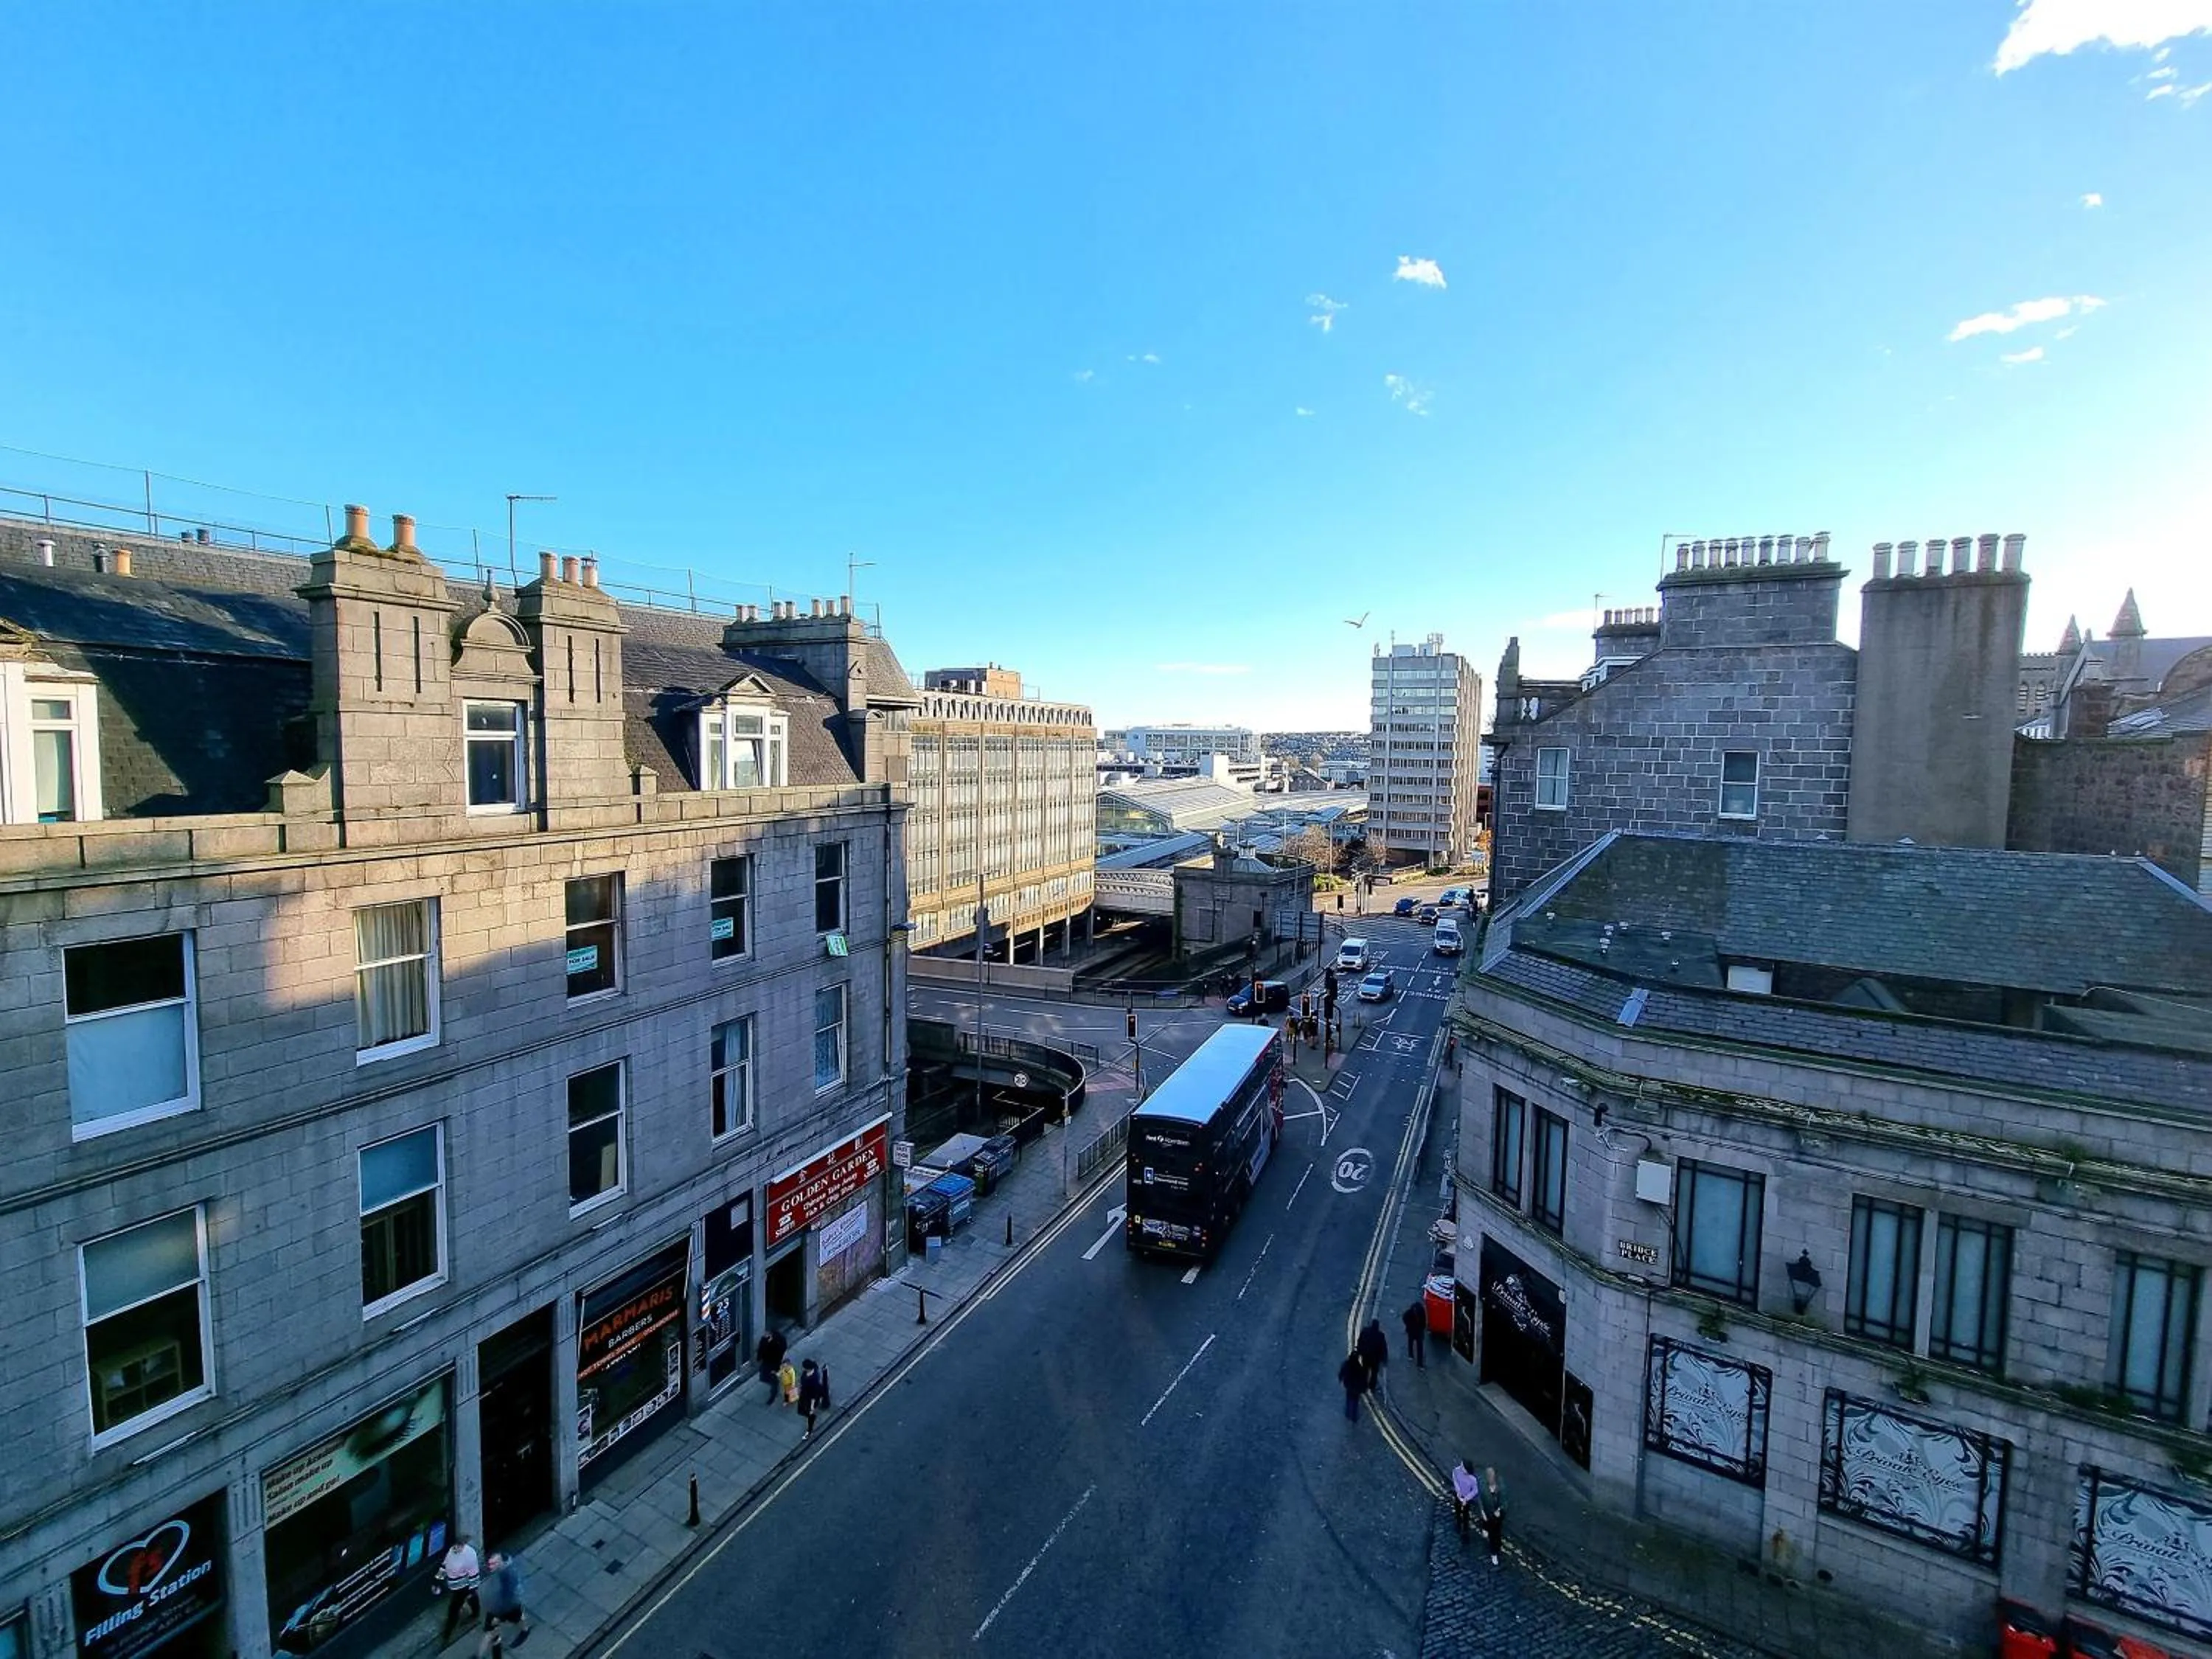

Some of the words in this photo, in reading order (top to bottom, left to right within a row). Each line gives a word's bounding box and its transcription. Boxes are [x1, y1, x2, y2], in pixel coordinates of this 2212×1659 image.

[781, 1176, 830, 1212] GOLDEN
[832, 1147, 876, 1181] GARDEN
[803, 1192, 827, 1211] Chinese
[1619, 1240, 1658, 1257] BRIDGE
[1621, 1248, 1656, 1265] PLACE
[716, 1297, 729, 1315] 23
[1491, 1280, 1526, 1312] Private
[582, 1284, 675, 1353] MARMARIS
[608, 1313, 654, 1349] BARBERS
[1667, 1386, 1714, 1407] Private
[1718, 1403, 1747, 1420] Eyes
[266, 1471, 291, 1489] Make
[294, 1466, 321, 1486] make
[1859, 1450, 1917, 1473] Private
[1922, 1469, 1961, 1488] Eyes
[266, 1504, 293, 1526] Make
[293, 1496, 307, 1508] up
[306, 1484, 325, 1500] and
[2112, 1531, 2187, 1562] Private
[84, 1599, 145, 1647] Filling
[148, 1559, 212, 1607] Station
